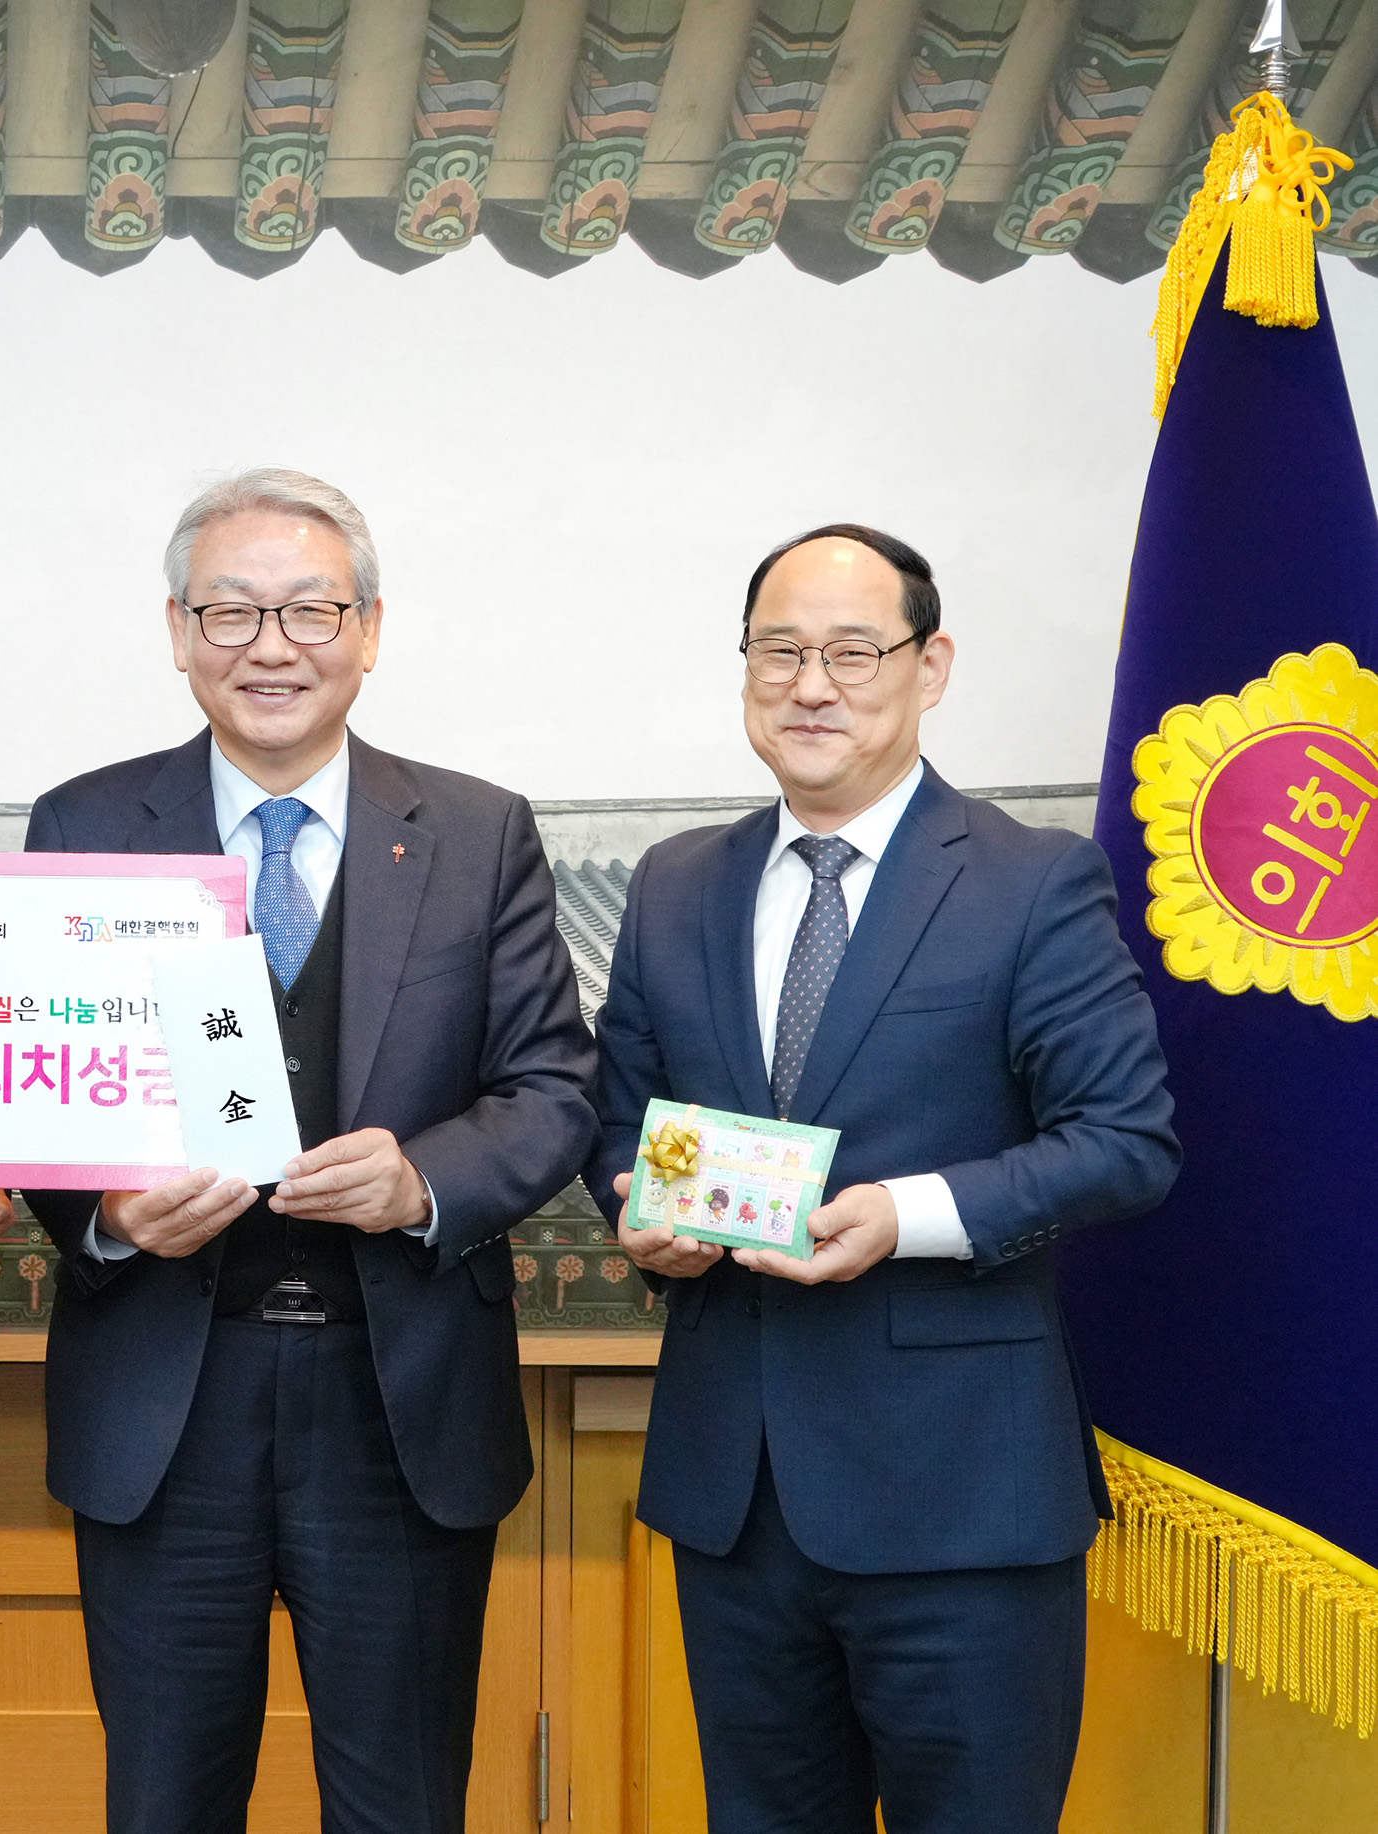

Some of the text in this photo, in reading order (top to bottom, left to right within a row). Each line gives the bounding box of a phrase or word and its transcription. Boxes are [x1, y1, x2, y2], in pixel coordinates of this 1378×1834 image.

[1251, 745, 1378, 934] 의회
[115, 920, 199, 935] 대한결핵협회
[201, 1008, 256, 1124] 誠金
